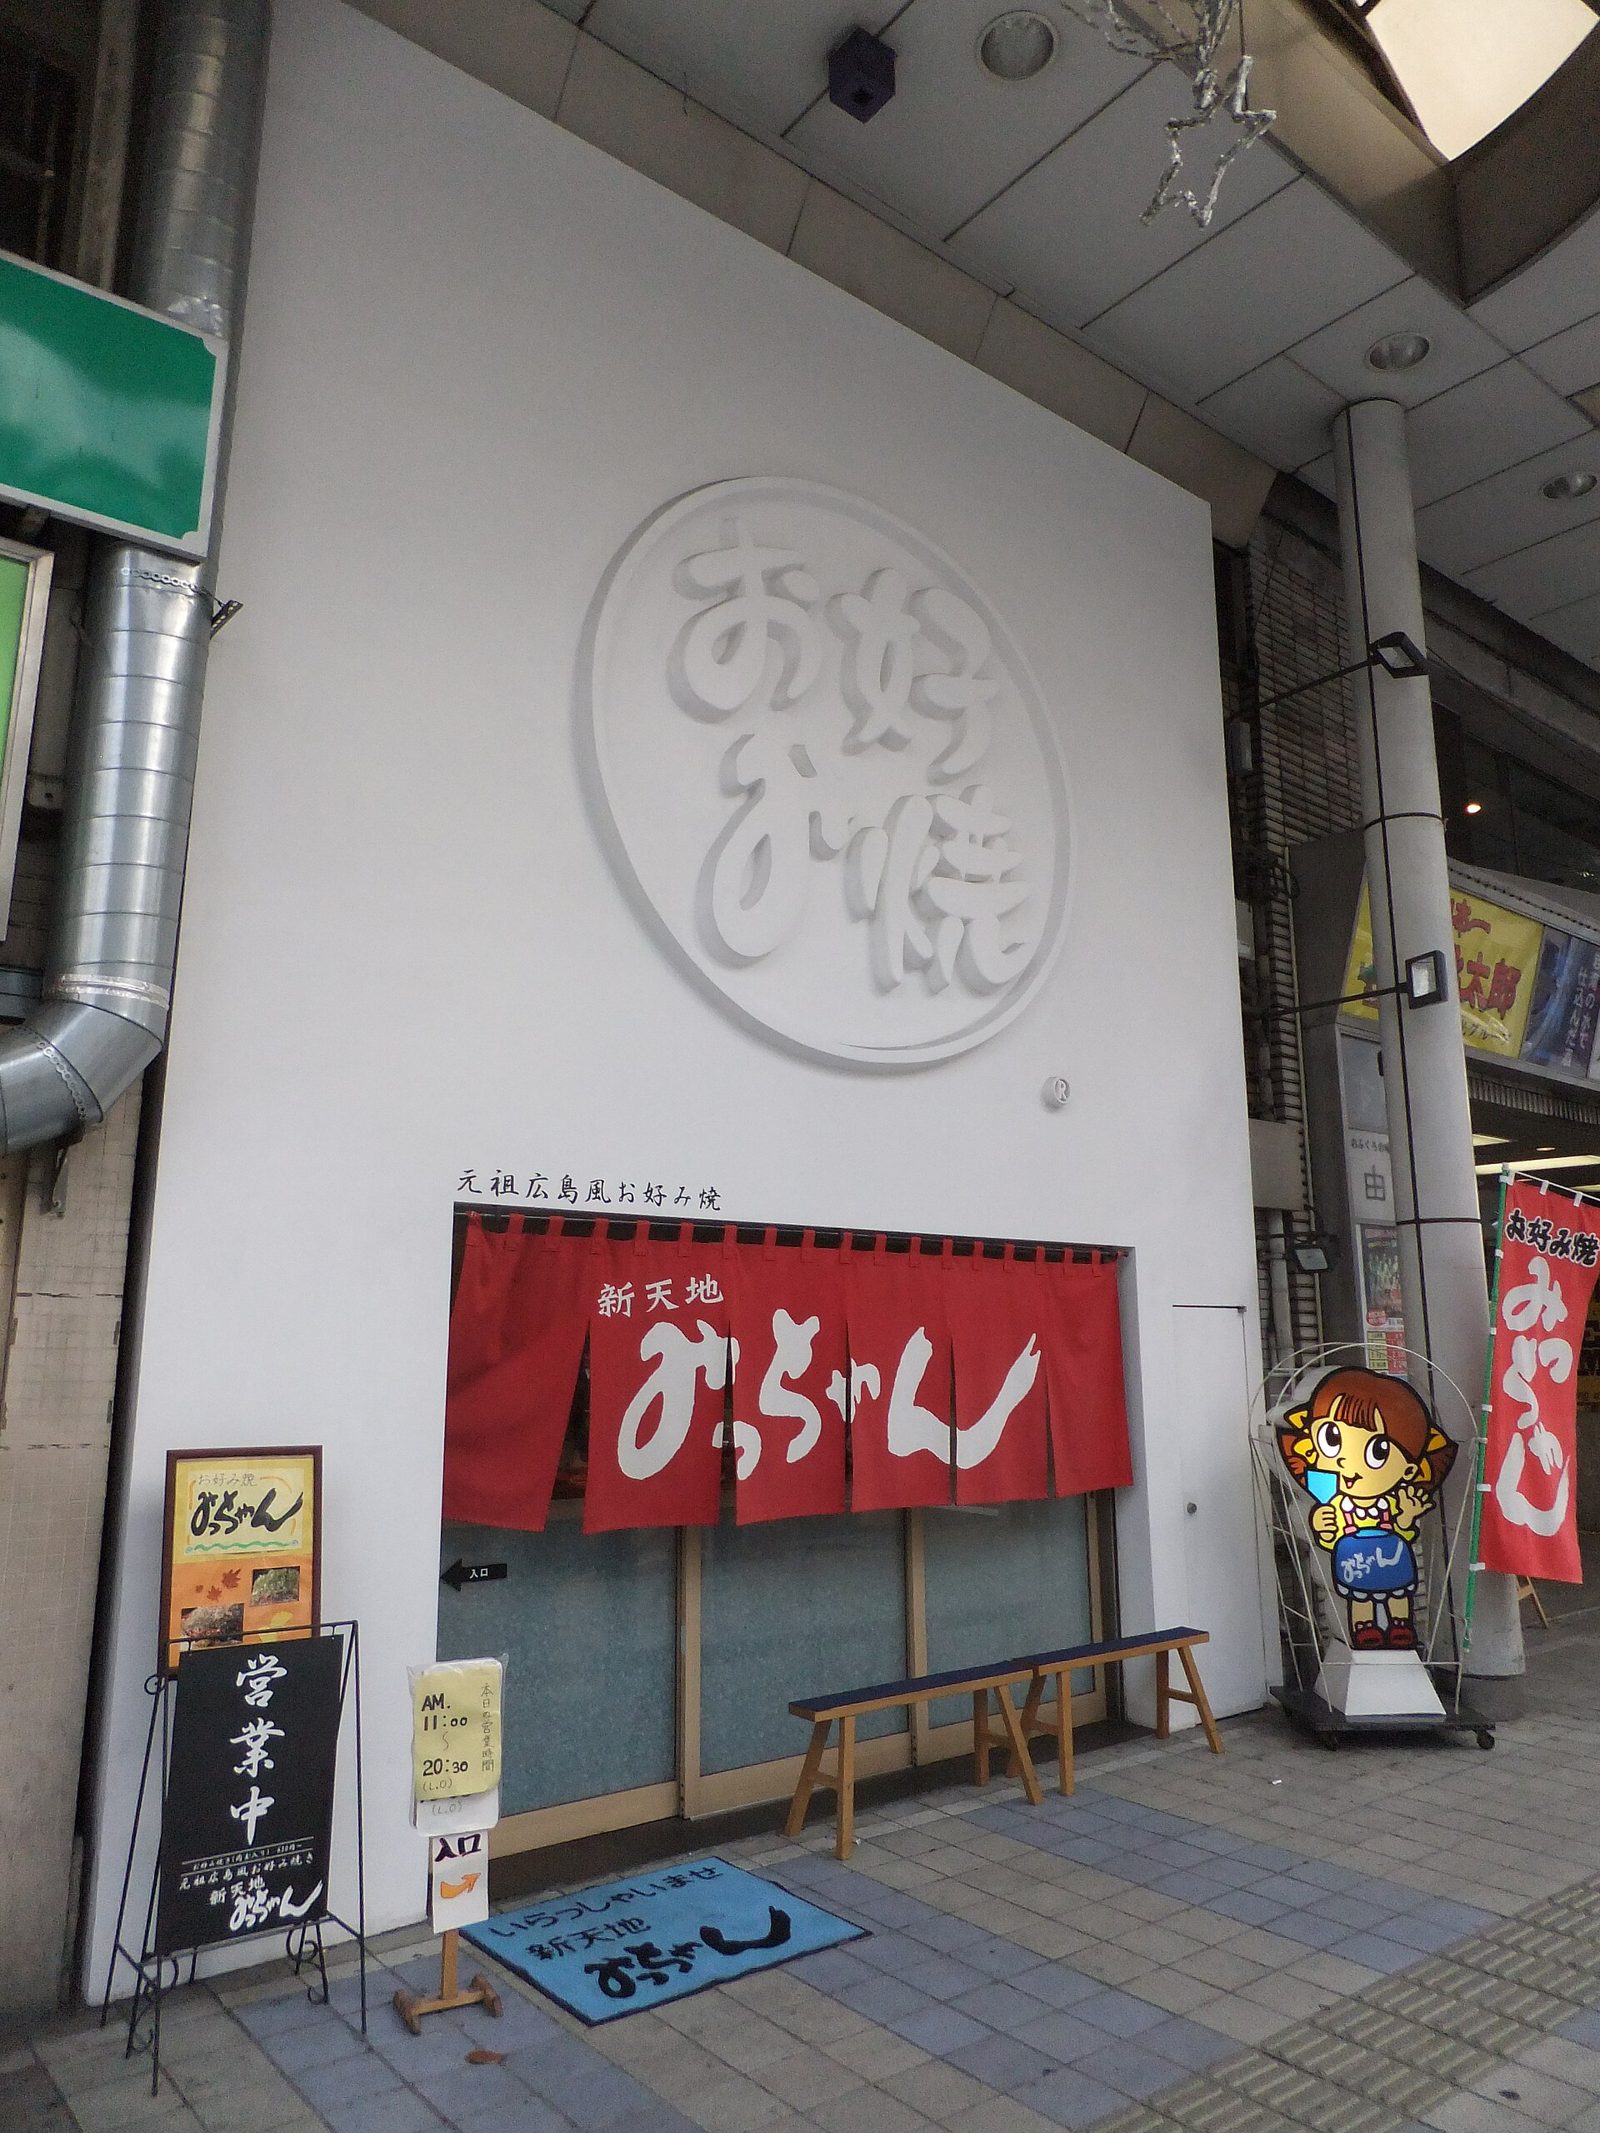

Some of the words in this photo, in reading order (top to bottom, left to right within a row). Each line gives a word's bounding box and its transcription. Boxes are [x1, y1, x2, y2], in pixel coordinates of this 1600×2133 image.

[456, 1168, 722, 1212] 元祖広島風お好み焼
[1504, 1208, 1600, 1268] お好み焼
[597, 1273, 725, 1317] 新天地
[617, 1307, 1042, 1481] みっちゃん
[190, 1487, 304, 1537] みっちゃん
[469, 1568, 489, 1579] 入口
[421, 1692, 451, 1712] AM.
[423, 1714, 468, 1732] 11:00
[229, 1652, 288, 1847] 営業中
[422, 1757, 469, 1777] 20:30
[434, 1832, 482, 1863] 入口
[209, 1875, 266, 1906] 新天地
[489, 1865, 724, 1938] いらっしゃいませ
[524, 1914, 652, 1962] 新天地
